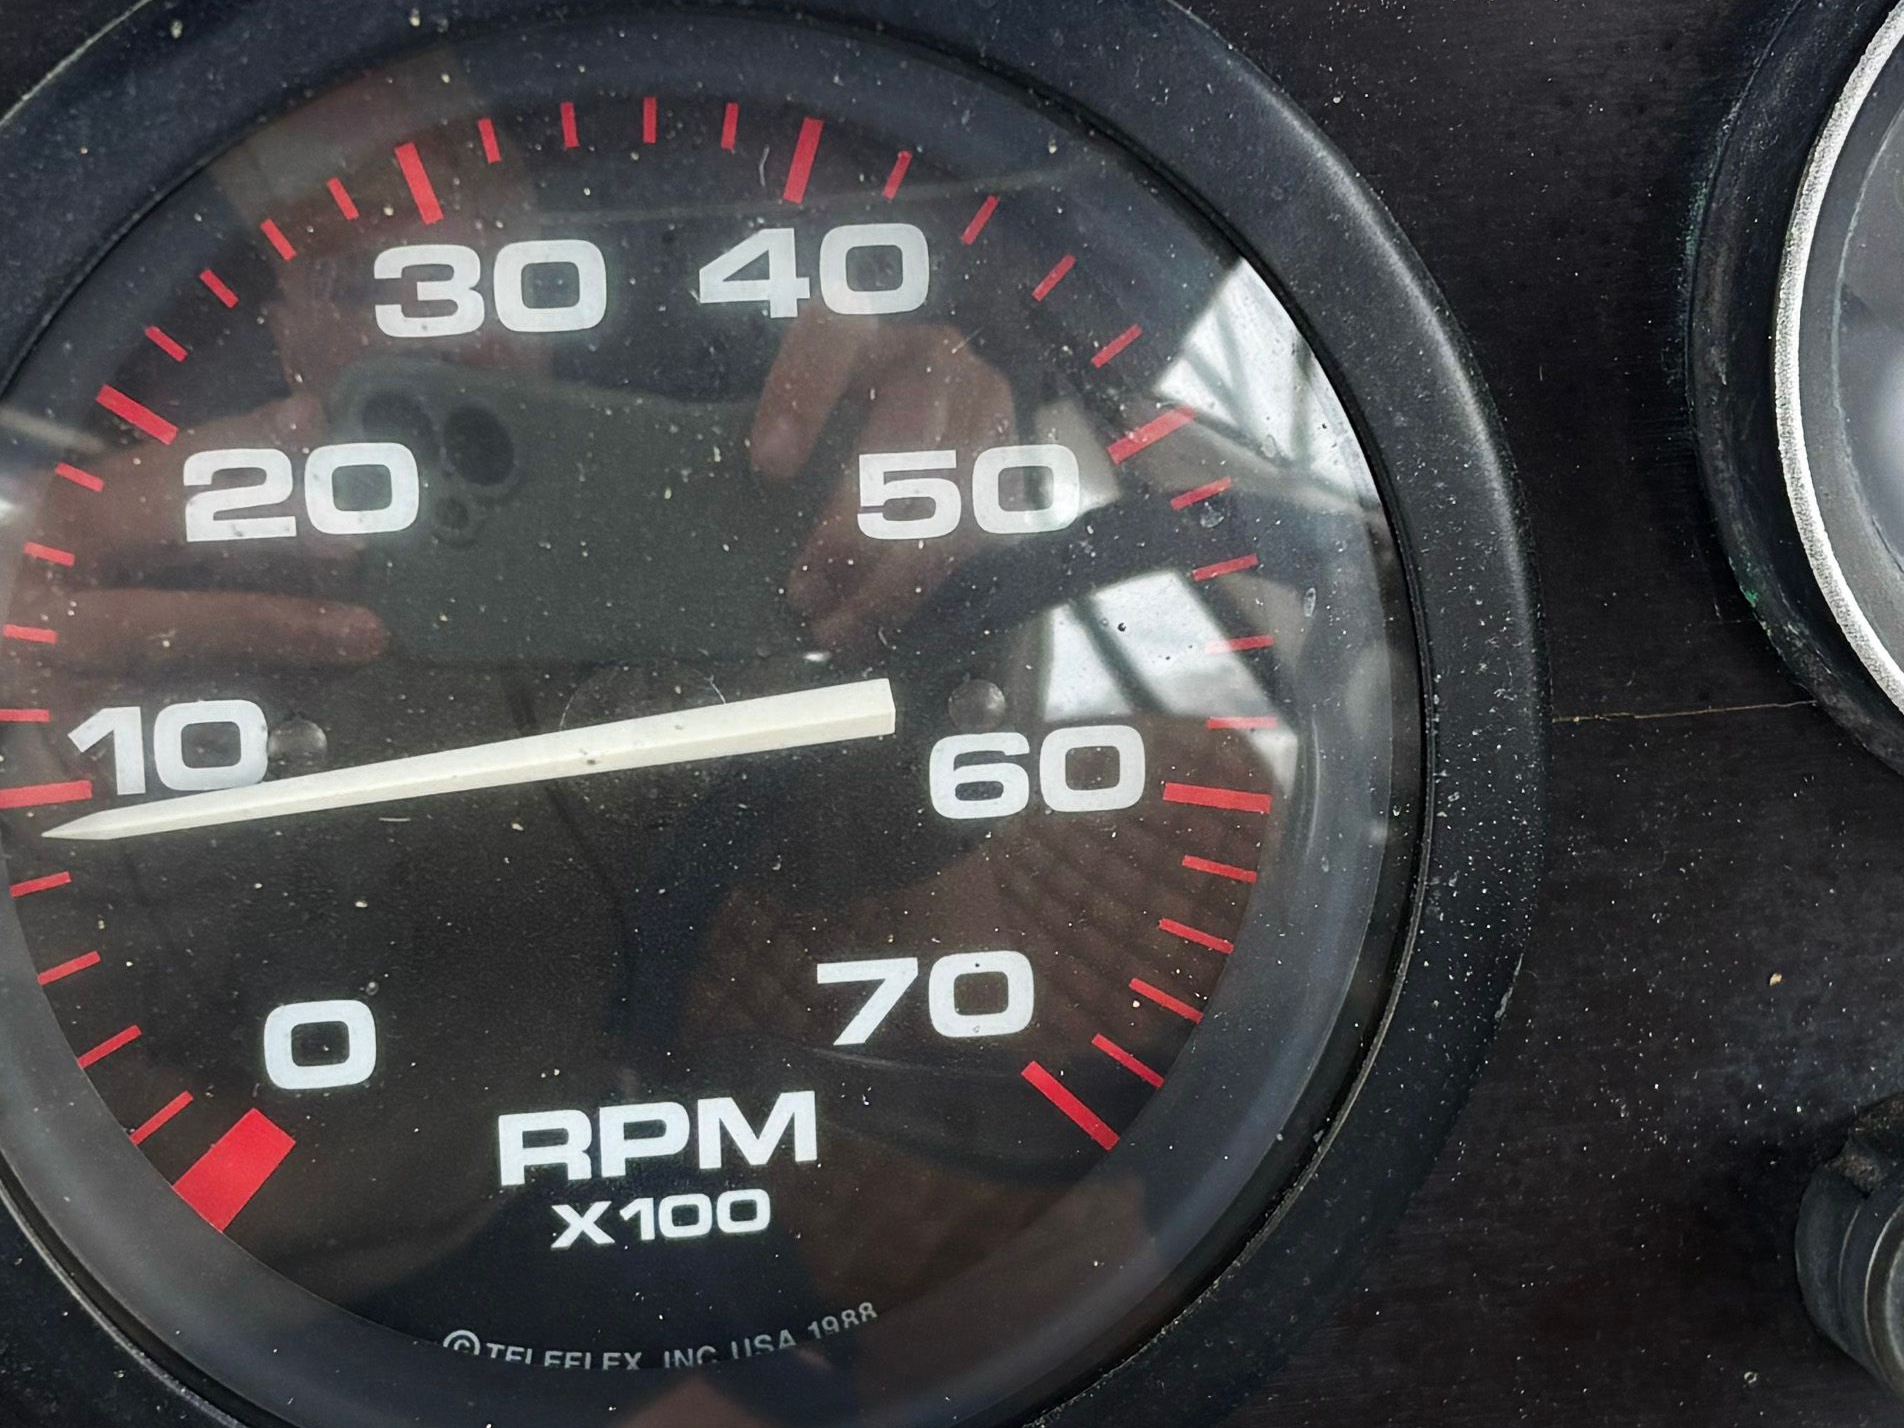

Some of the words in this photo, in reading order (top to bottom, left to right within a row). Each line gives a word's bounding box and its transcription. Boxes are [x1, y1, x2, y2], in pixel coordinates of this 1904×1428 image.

[374, 240, 606, 337] 30
[699, 223, 929, 318] 40
[183, 443, 419, 542] 20
[857, 444, 1083, 539] 50
[67, 699, 269, 797] 10
[928, 724, 1146, 819] 60
[264, 1000, 376, 1089] 0
[817, 951, 1034, 1045] 70
[498, 1091, 817, 1186] RPM
[552, 1189, 770, 1248] X100
[808, 1302, 877, 1338] 1988
